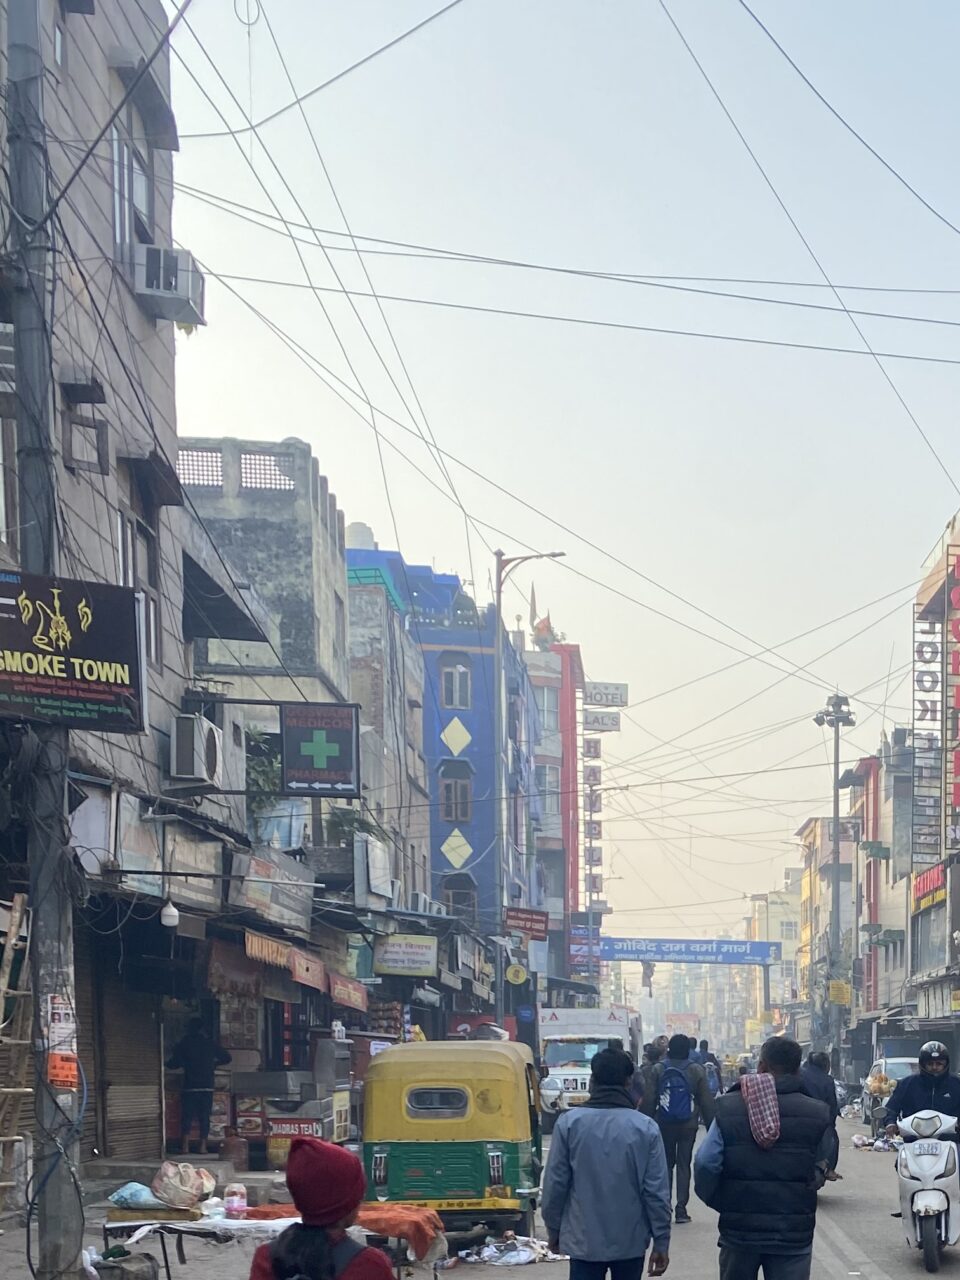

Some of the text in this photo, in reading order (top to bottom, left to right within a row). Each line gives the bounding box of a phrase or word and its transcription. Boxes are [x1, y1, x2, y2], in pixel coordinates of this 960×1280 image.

[70, 658, 130, 684] TOWN
[585, 691, 626, 705] HOTEL
[287, 718, 352, 729] MEDICOS
[661, 943, 686, 952] राम
[690, 941, 717, 952] वर्मा
[721, 942, 751, 954] मार्ग
[272, 1123, 312, 1135] MADRAS TEA
